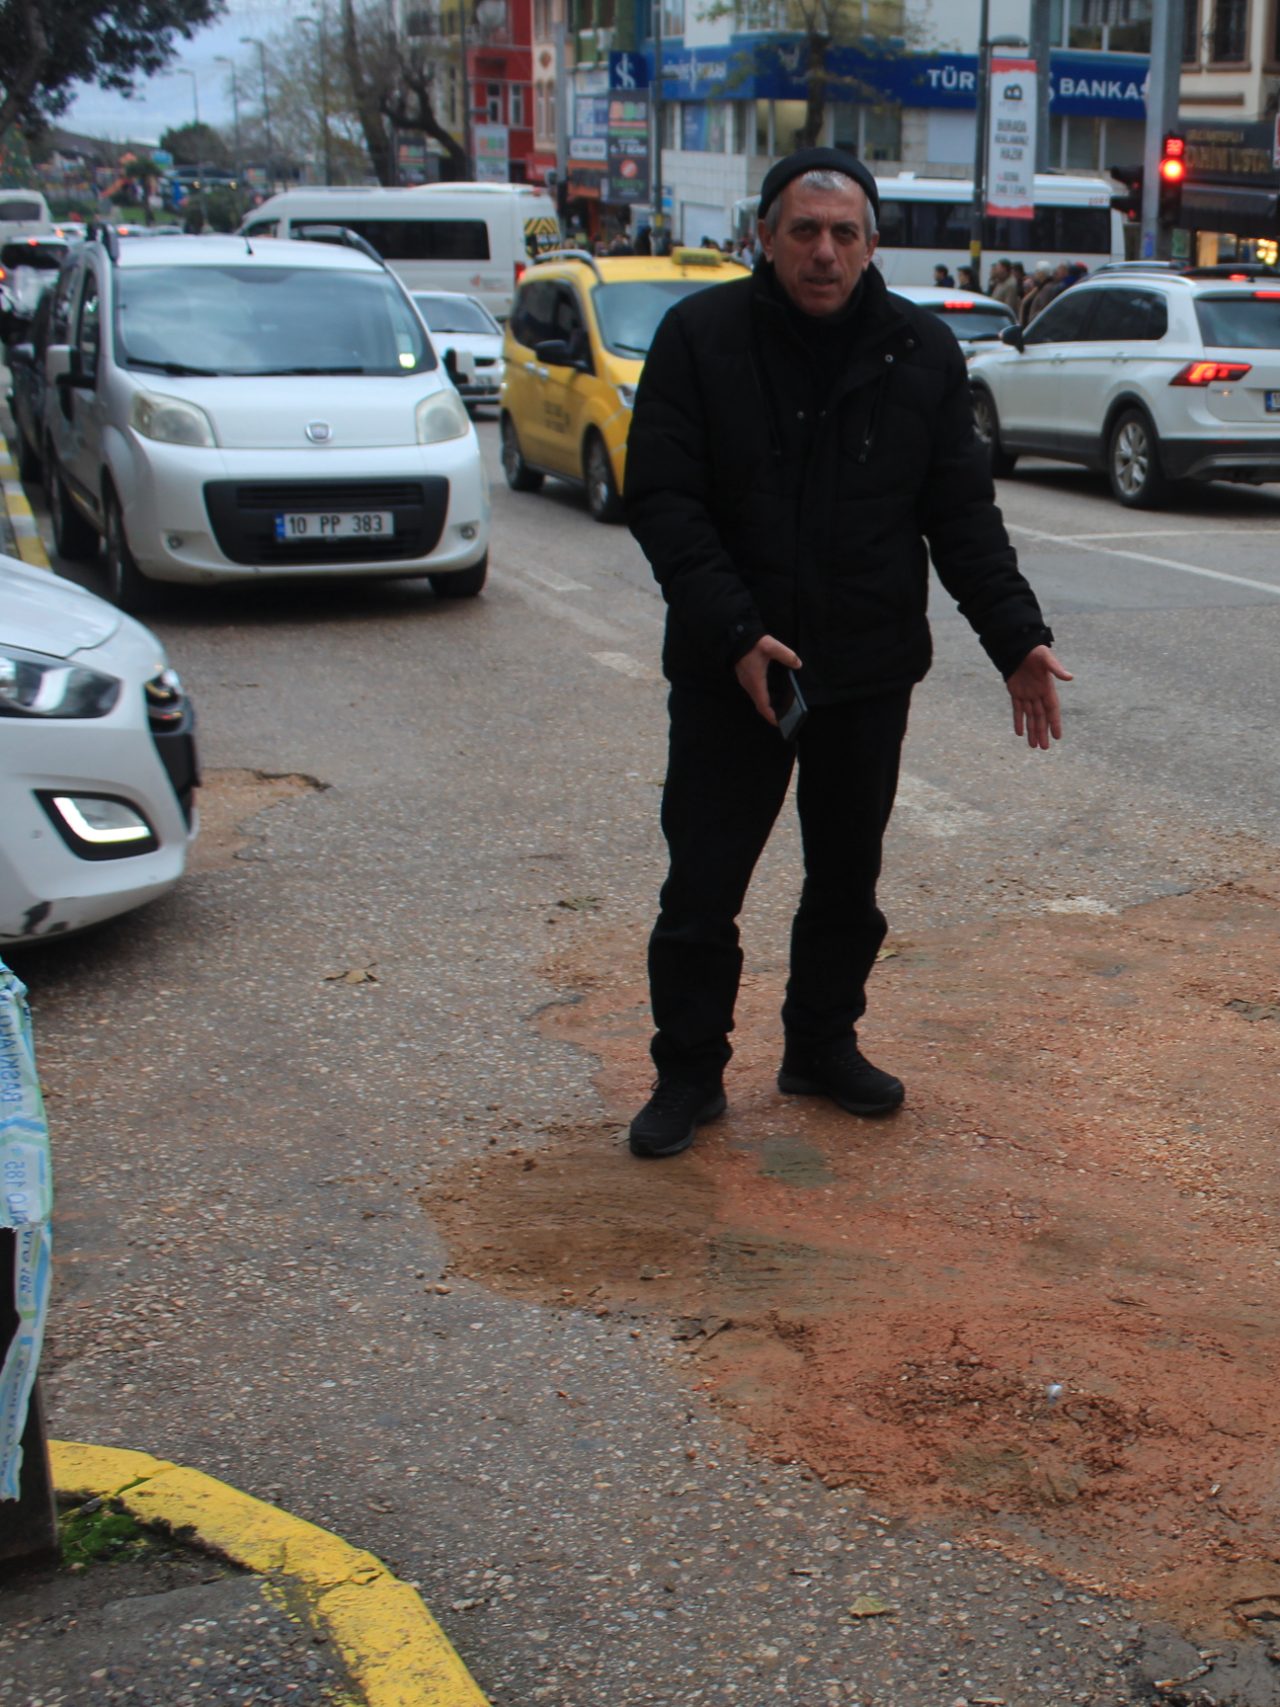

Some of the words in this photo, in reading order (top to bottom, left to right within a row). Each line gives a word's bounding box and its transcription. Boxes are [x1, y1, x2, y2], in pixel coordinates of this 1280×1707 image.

[928, 66, 976, 90] TÜR
[289, 516, 307, 535] 10
[320, 515, 341, 534] PP
[352, 514, 383, 533] 383
